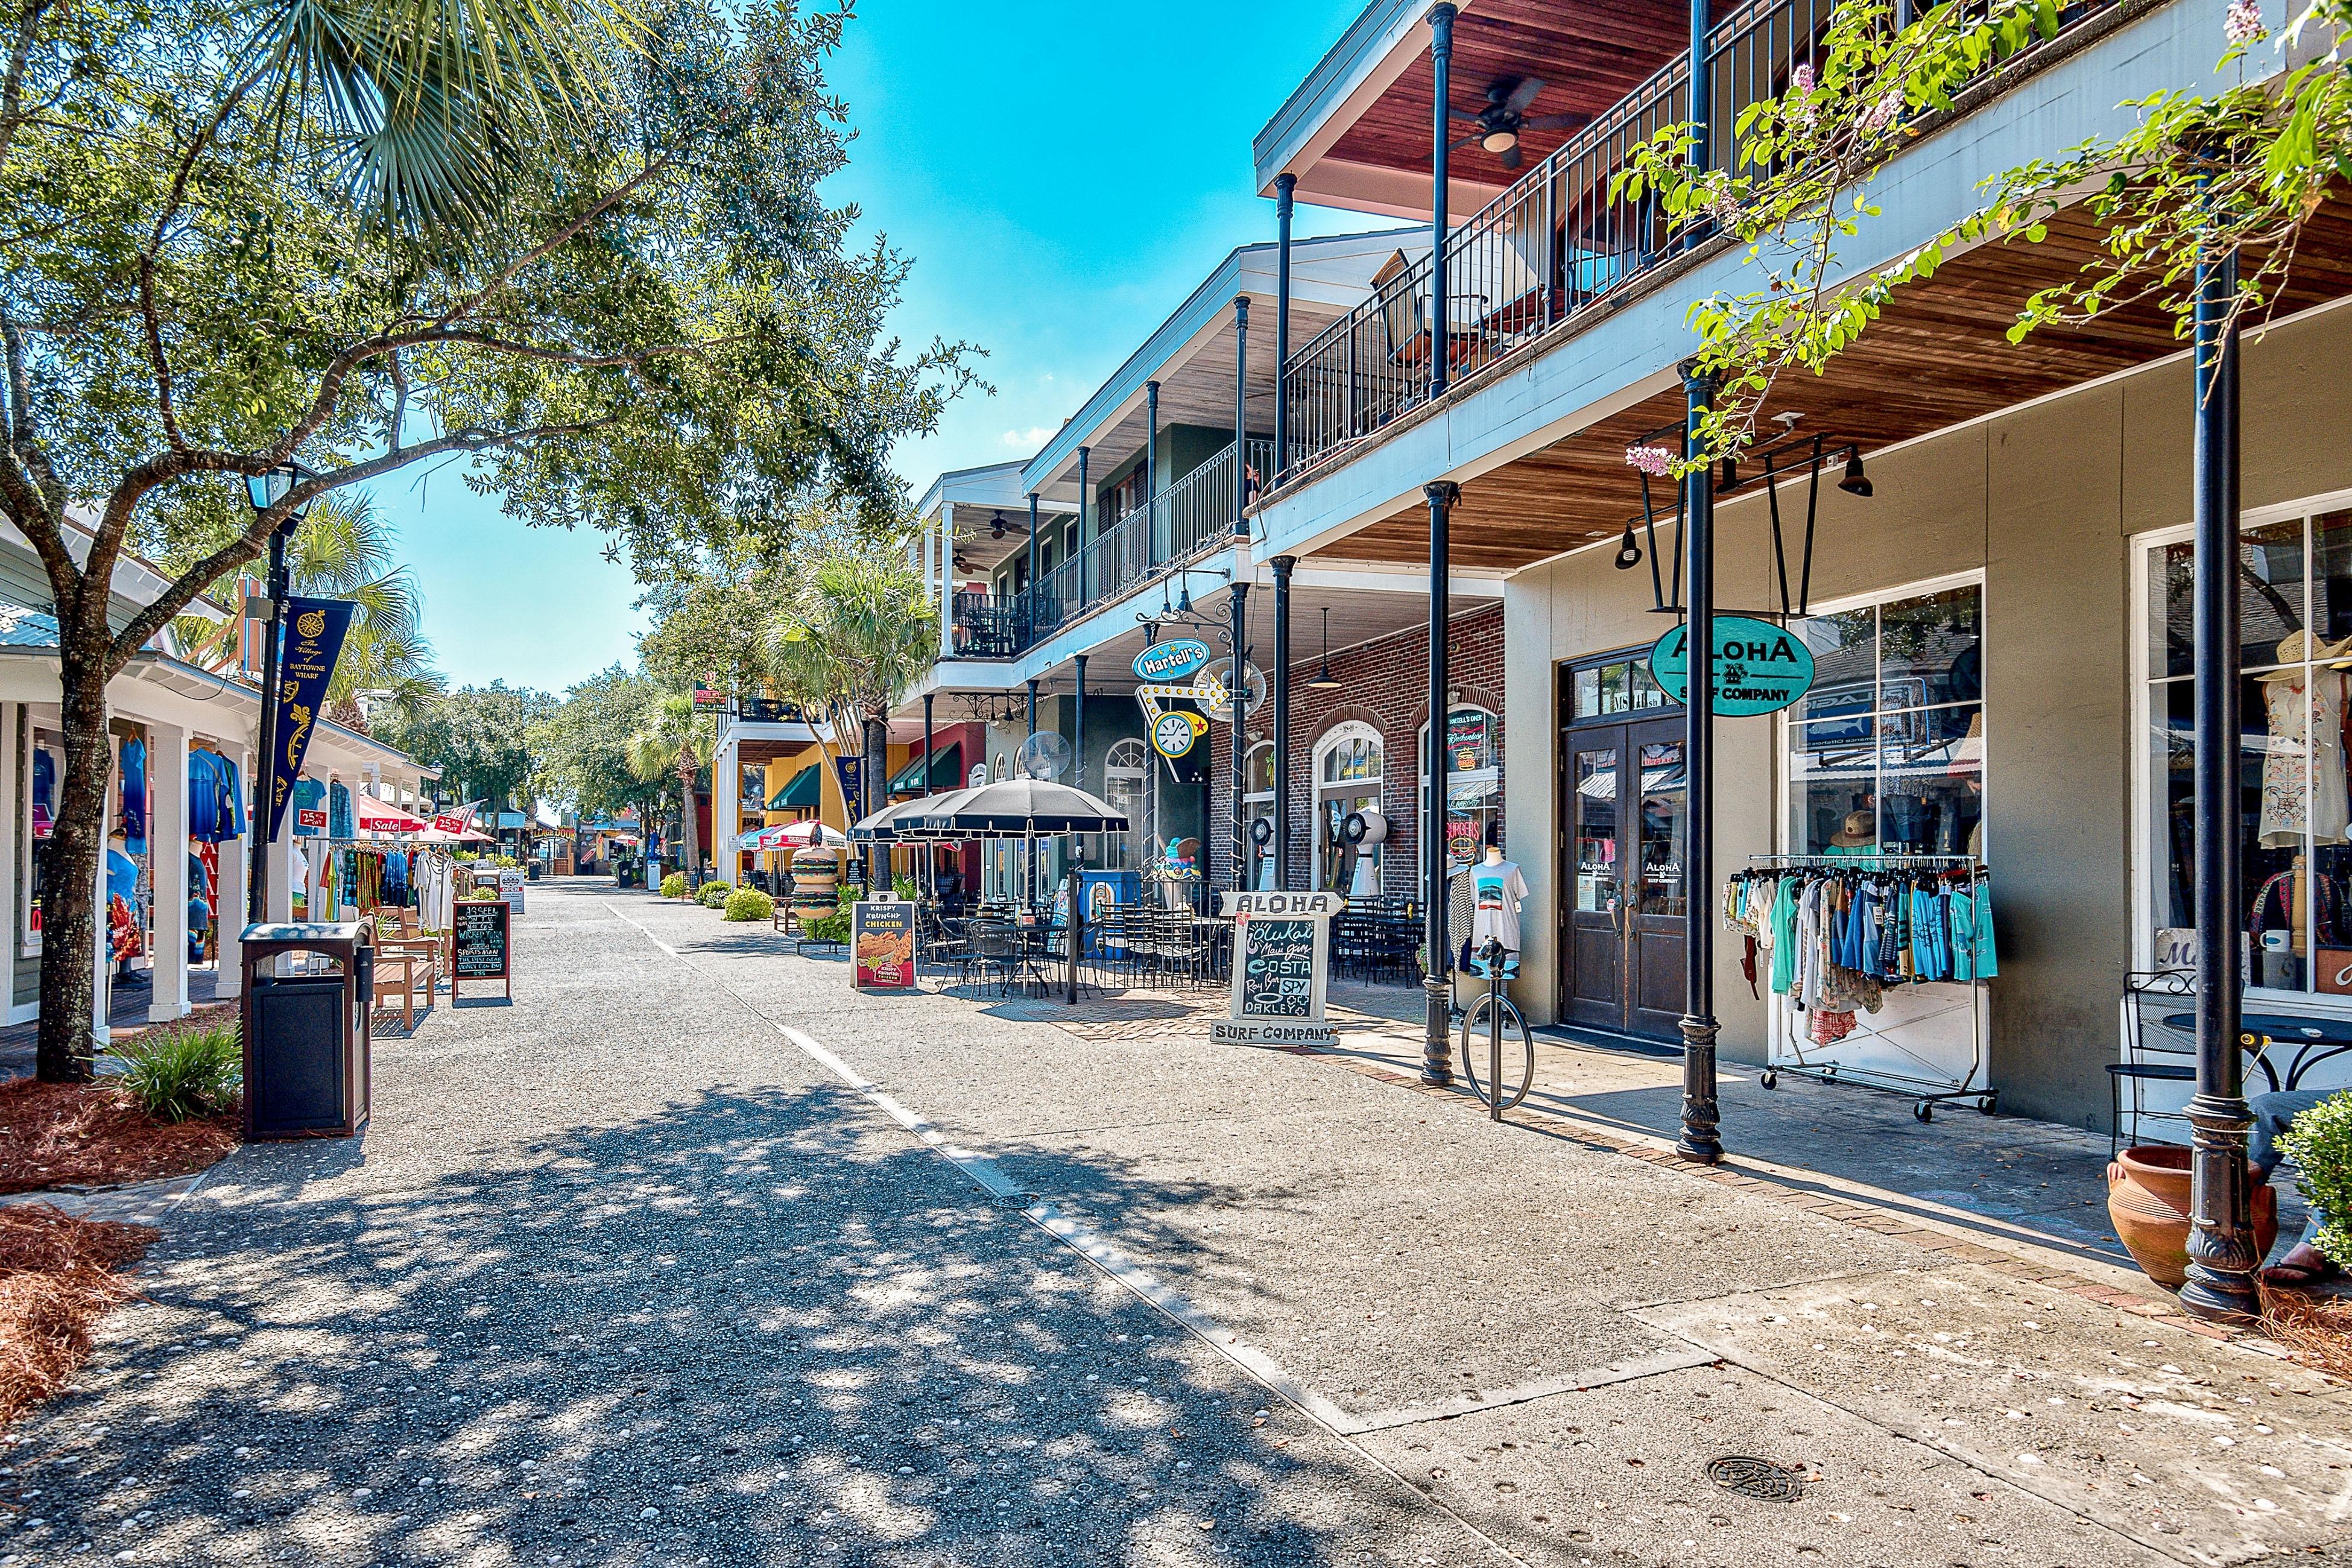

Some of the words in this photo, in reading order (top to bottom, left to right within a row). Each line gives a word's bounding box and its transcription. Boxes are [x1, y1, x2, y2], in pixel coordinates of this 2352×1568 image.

[295, 646, 323, 656] Village
[1671, 631, 1798, 663] AOHA
[1143, 646, 1204, 675] Hartell's
[289, 663, 326, 672] BAYTOWNE
[1679, 686, 1719, 700] SF
[1722, 687, 1790, 702] COMPANY
[1447, 732, 1484, 744] Budweiser
[1450, 800, 1481, 808] LIGHT
[303, 812, 324, 823] 25%
[439, 818, 460, 828] 25%
[373, 820, 399, 830] Sale
[1446, 821, 1480, 841] BURGERS
[534, 828, 554, 838] LLAGE
[554, 828, 577, 842] DOOR
[1581, 861, 1611, 870] ALOHA
[1646, 862, 1680, 871] ALOHA
[1236, 894, 1328, 914] ALOHA
[1260, 942, 1284, 955] Maui
[1247, 959, 1311, 975] COSTA
[1245, 979, 1263, 994] Ray
[1282, 979, 1307, 993] SPY
[1245, 1002, 1296, 1014] OAKLEY
[1215, 1025, 1259, 1040] SURF
[1262, 1026, 1333, 1041] COMPANY
